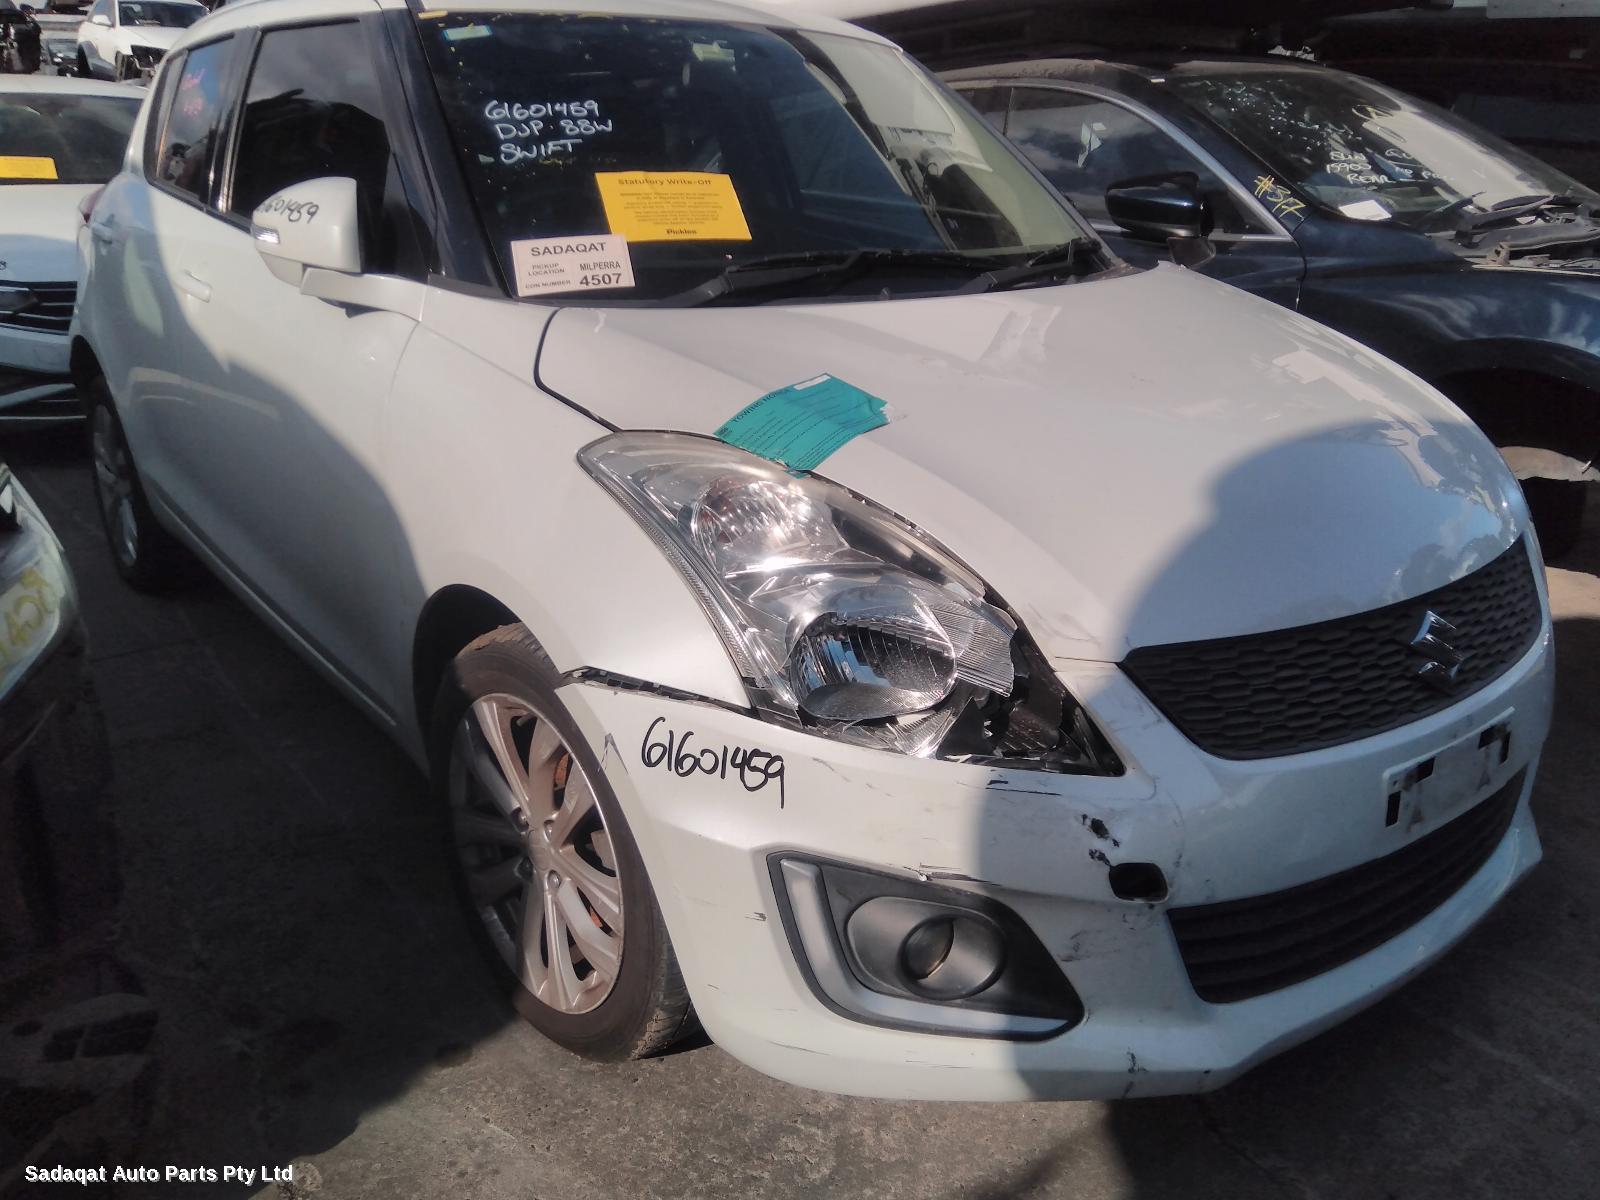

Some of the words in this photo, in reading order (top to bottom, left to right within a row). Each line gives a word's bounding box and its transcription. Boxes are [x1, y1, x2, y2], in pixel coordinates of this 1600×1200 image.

[485, 100, 599, 120] 61601459
[495, 120, 543, 140] DJP
[560, 119, 612, 135] 88W
[500, 139, 583, 163] SWIFT
[618, 178, 664, 186] Statutory
[666, 178, 712, 186] Write-Off
[531, 242, 607, 257] SADAQAT
[528, 268, 565, 276] LOCATION
[531, 262, 560, 270] PICKUP
[579, 260, 622, 271] MILPERRA
[541, 279, 571, 287] NUMBER
[579, 272, 623, 287] 4507
[641, 716, 786, 810] 61601459
